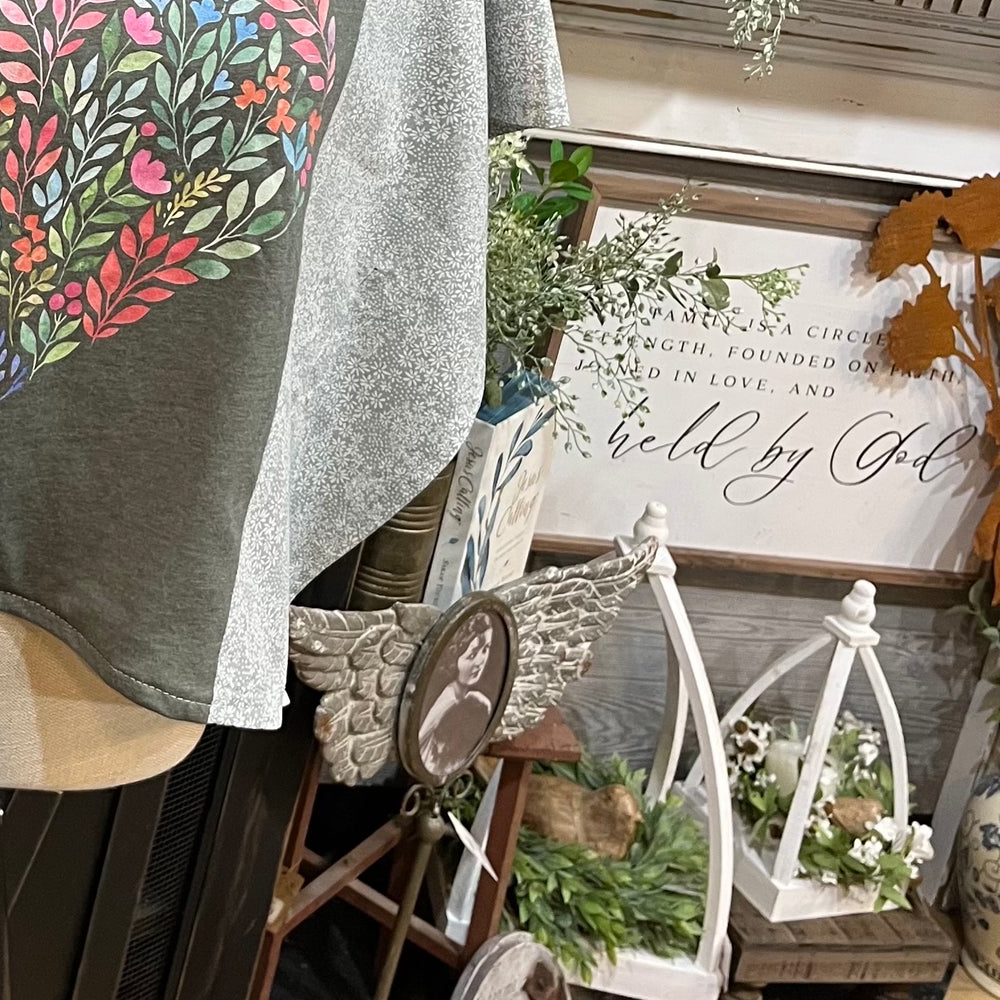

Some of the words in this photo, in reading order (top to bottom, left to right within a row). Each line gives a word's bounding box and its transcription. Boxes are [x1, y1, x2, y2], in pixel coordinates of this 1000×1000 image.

[748, 318, 768, 333] IS
[780, 323, 793, 336] A
[806, 325, 888, 348] CIRCLE
[574, 358, 662, 380] JNED
[673, 369, 698, 384] IN
[709, 373, 775, 395] LOVE,
[788, 382, 836, 399] AND
[726, 345, 837, 370] FOUNDED
[847, 359, 880, 375] ON
[889, 362, 962, 385] FTH,
[463, 440, 484, 478] Jesus
[606, 395, 760, 471] held
[722, 410, 815, 507] by
[829, 410, 979, 487] God
[449, 475, 475, 527] Calling
